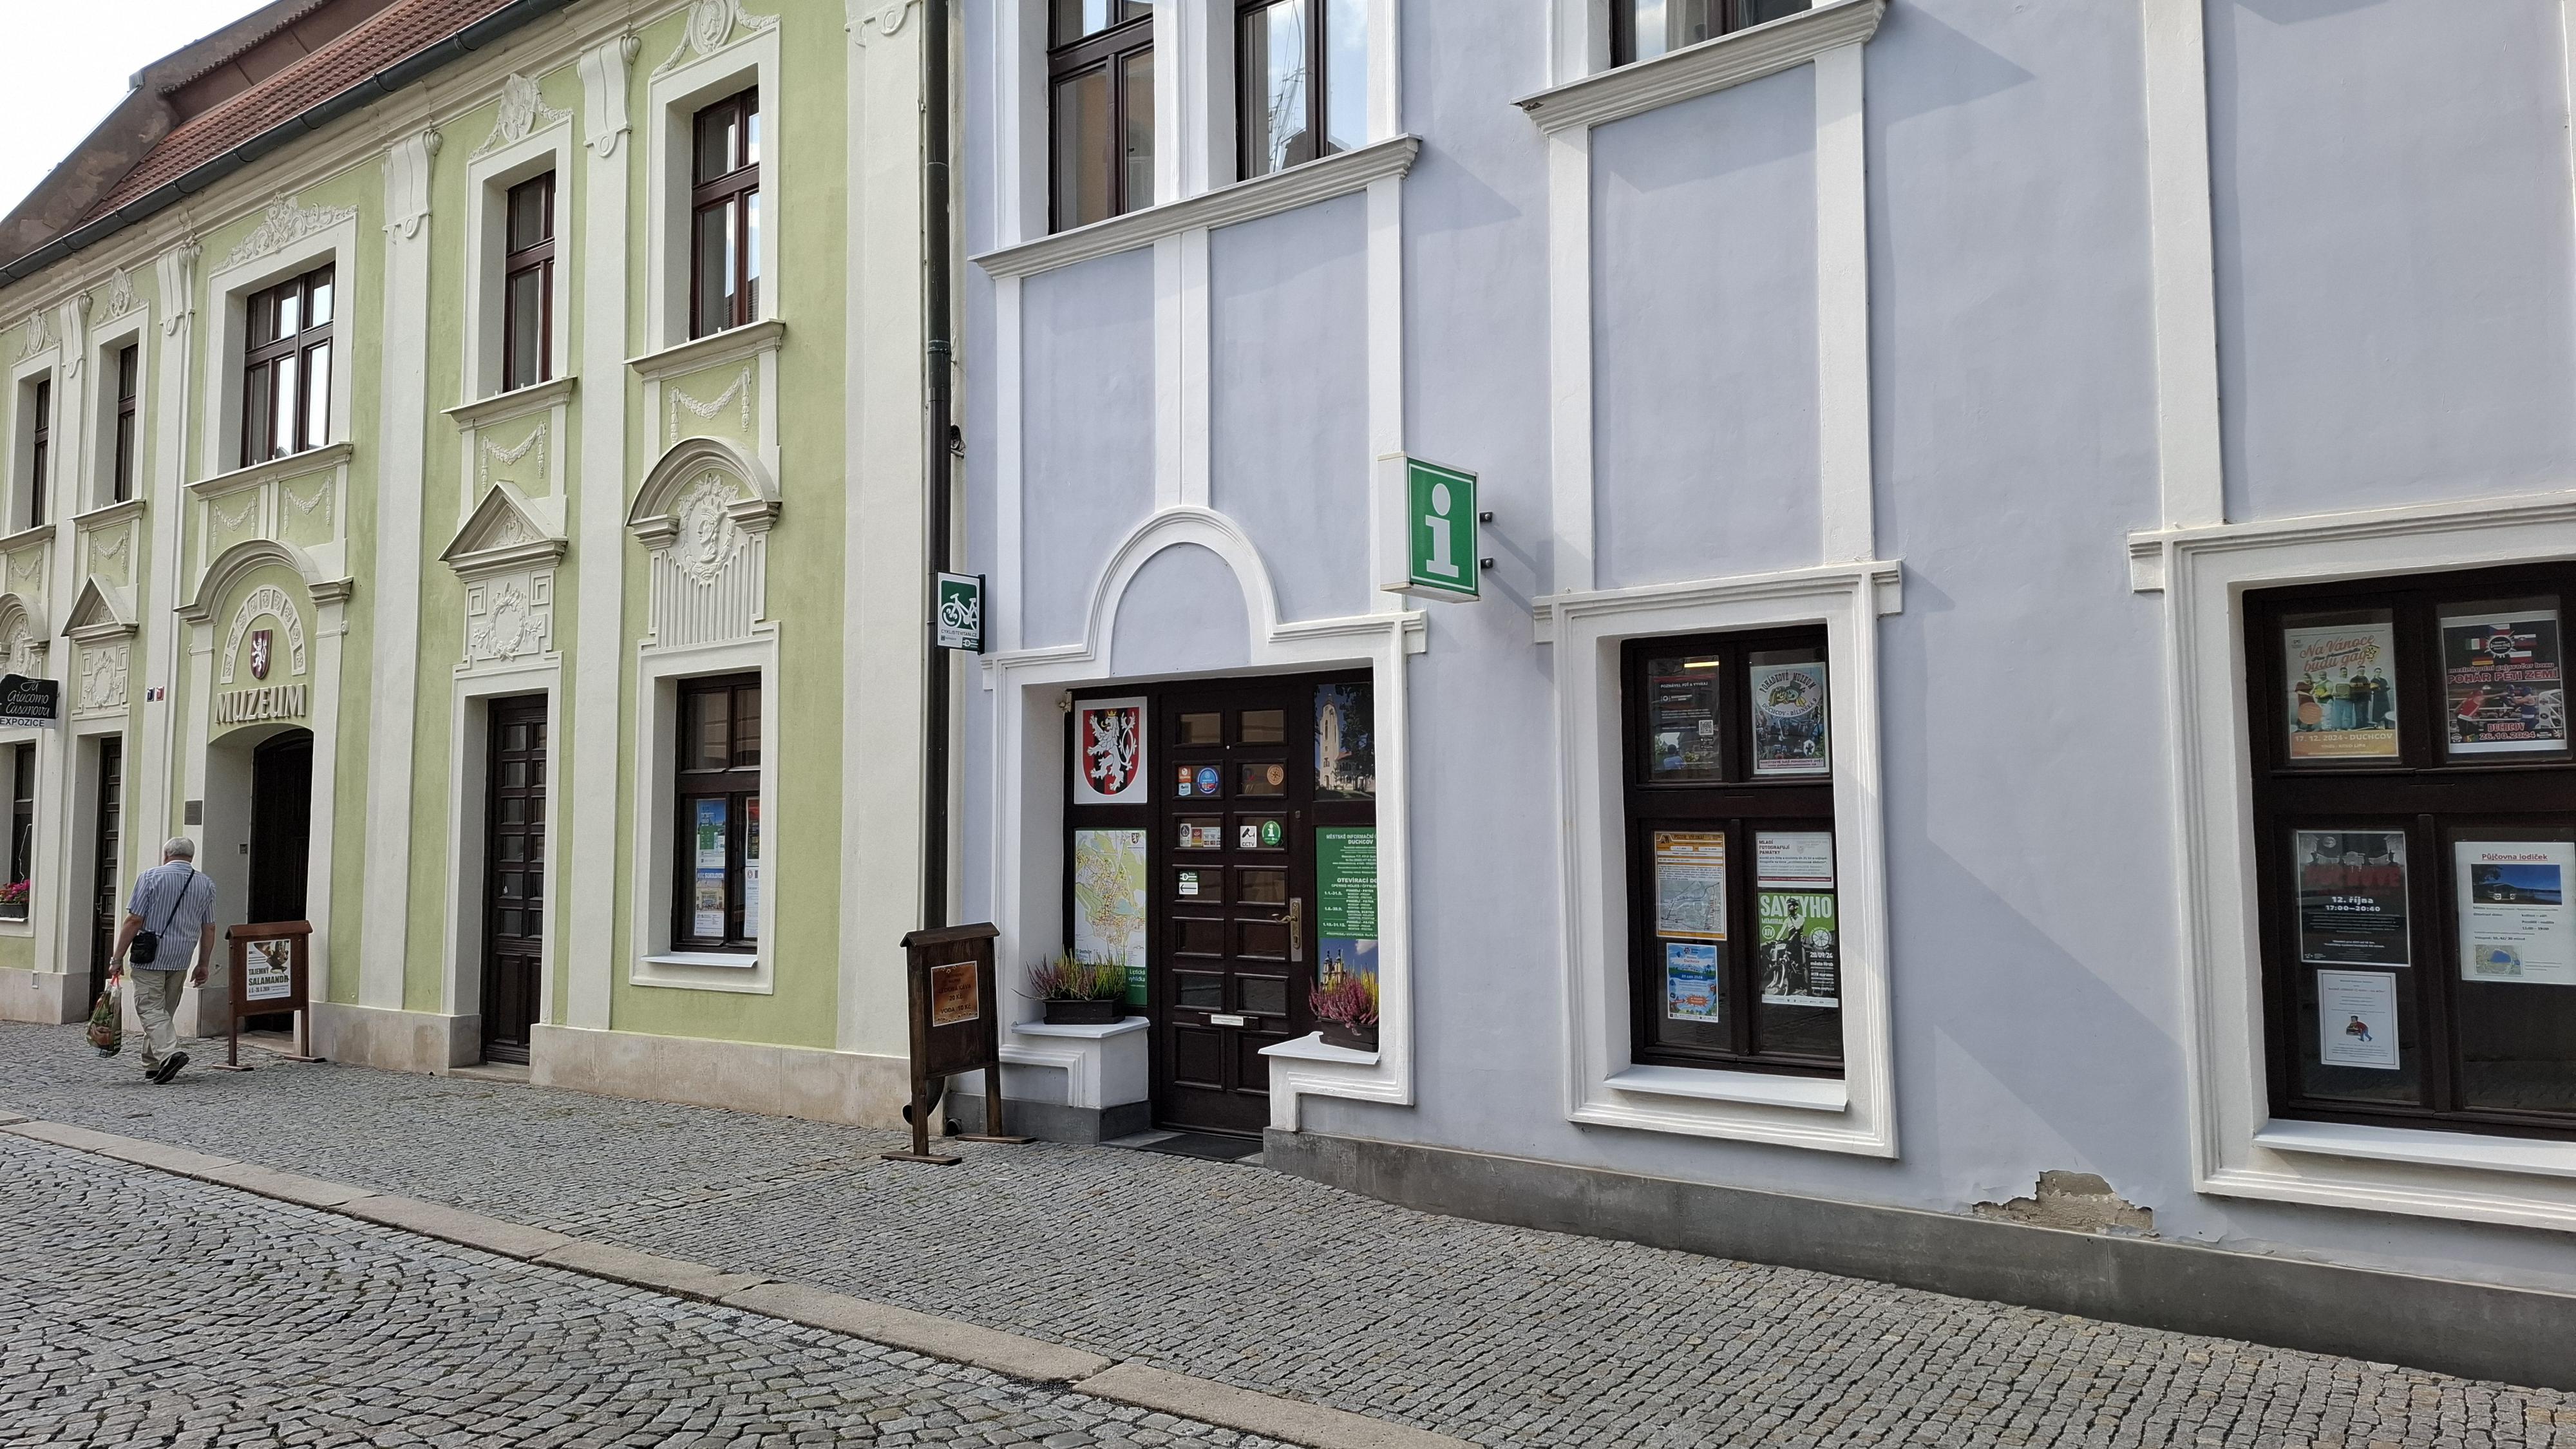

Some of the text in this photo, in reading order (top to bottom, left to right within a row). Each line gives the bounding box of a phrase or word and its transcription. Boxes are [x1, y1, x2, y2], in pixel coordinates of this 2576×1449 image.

[2300, 639, 2324, 659] Na
[2326, 634, 2375, 652] Vánoce
[2304, 656, 2338, 672] budu
[1793, 672, 1816, 690] MUZEUM
[2448, 671, 2491, 684] POHÁR
[2524, 667, 2559, 680] ZEMÍ
[214, 683, 306, 723] MUZEUM
[1761, 703, 1786, 715] DUCHCOV
[0, 717, 45, 726] EXPOZICE
[2487, 722, 2525, 732] DUCHCOV
[2479, 731, 2536, 740] 26.10.2024
[2349, 896, 2374, 905] října
[1764, 928, 1773, 936] XIV
